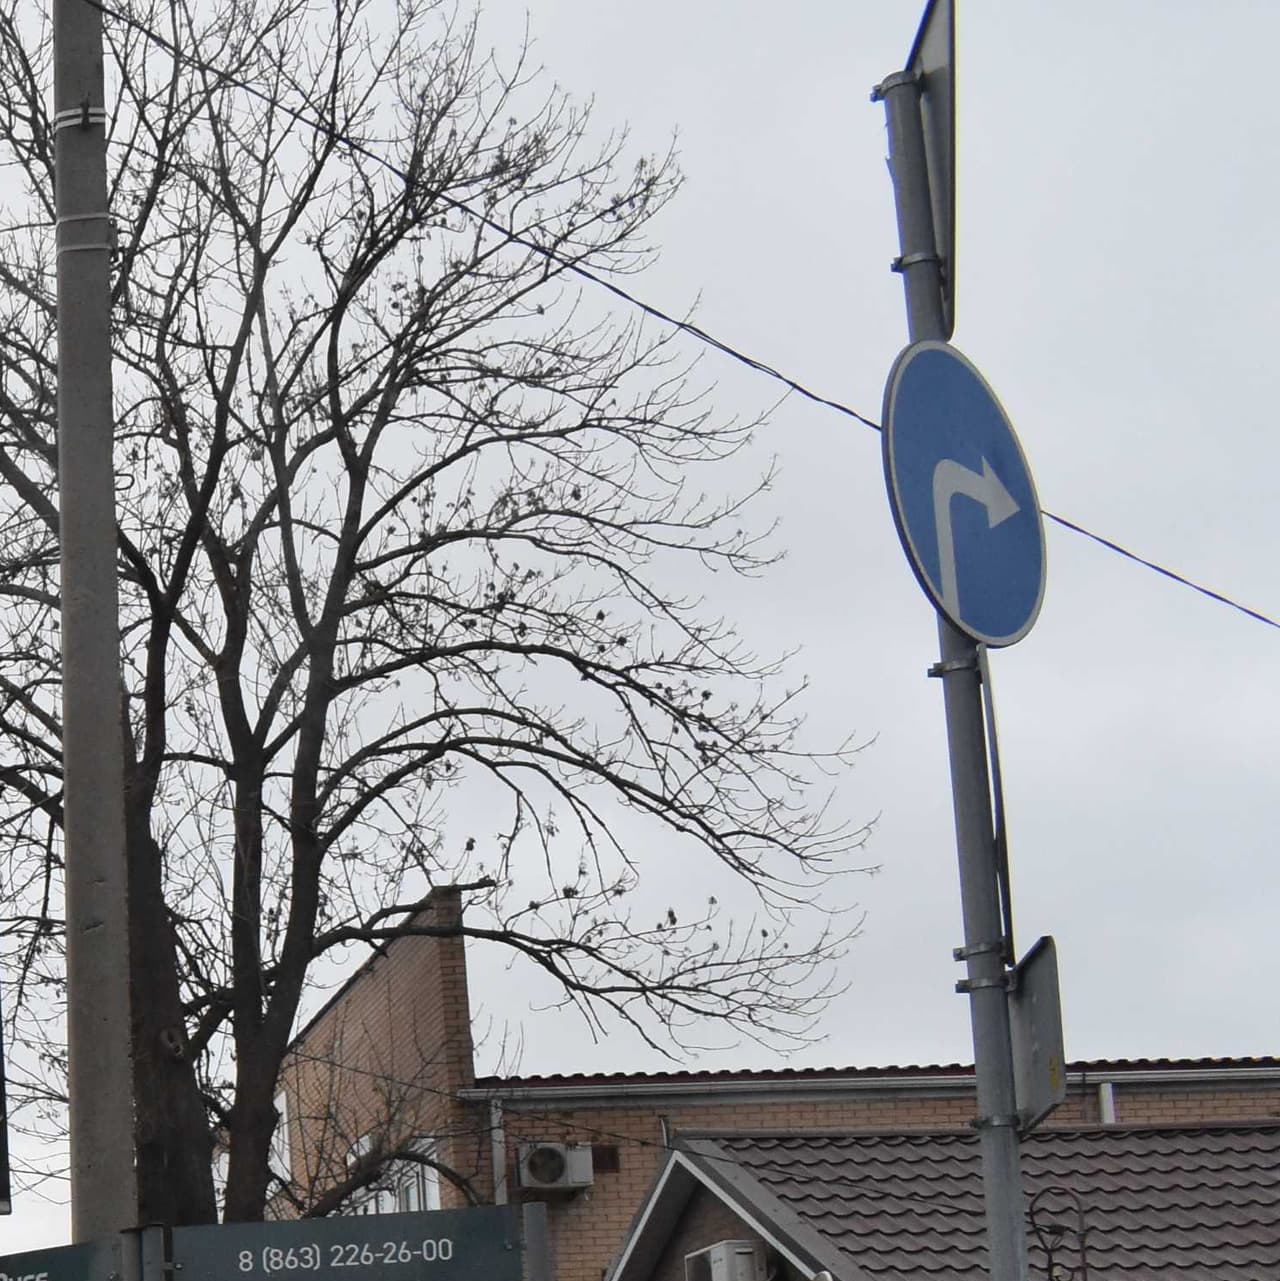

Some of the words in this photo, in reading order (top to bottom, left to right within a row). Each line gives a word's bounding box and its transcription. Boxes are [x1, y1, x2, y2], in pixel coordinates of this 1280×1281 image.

[238, 1250, 254, 1272] 8
[262, 1243, 321, 1273] (863)
[330, 1238, 454, 1267] 226-26-00
